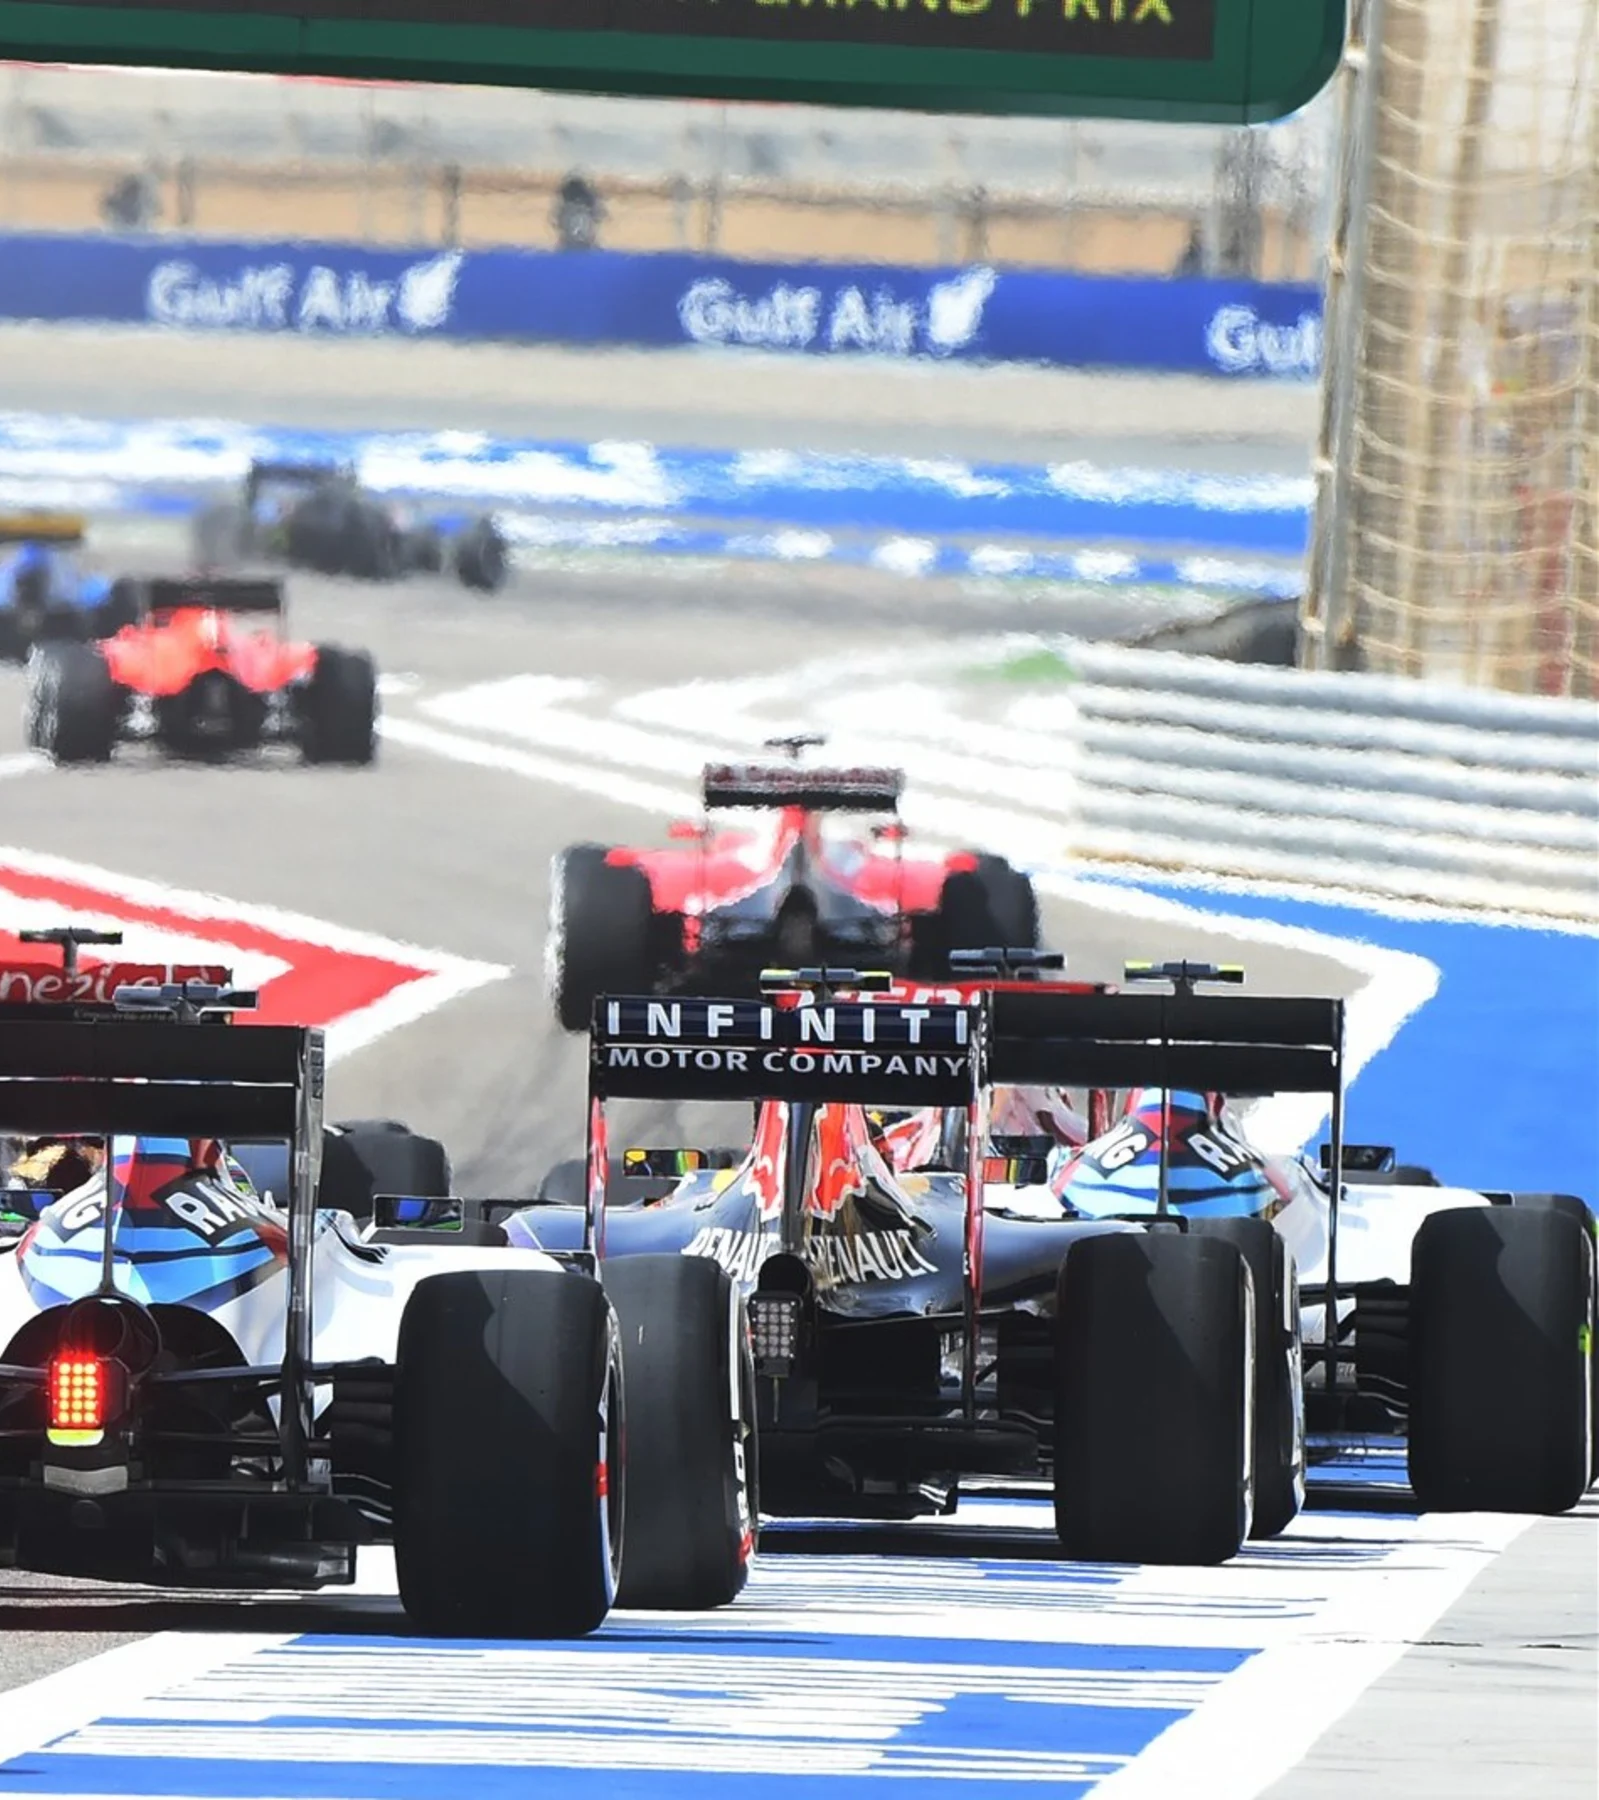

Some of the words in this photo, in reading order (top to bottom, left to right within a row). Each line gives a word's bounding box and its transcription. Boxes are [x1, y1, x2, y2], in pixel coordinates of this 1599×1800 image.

[147, 260, 296, 327] Gulf
[299, 266, 396, 330] Air
[678, 277, 820, 346] Gulf
[828, 285, 916, 351] Air
[606, 1002, 969, 1044] INFINITI
[607, 1049, 750, 1072] MOTOR
[763, 1051, 967, 1076] COMPANY
